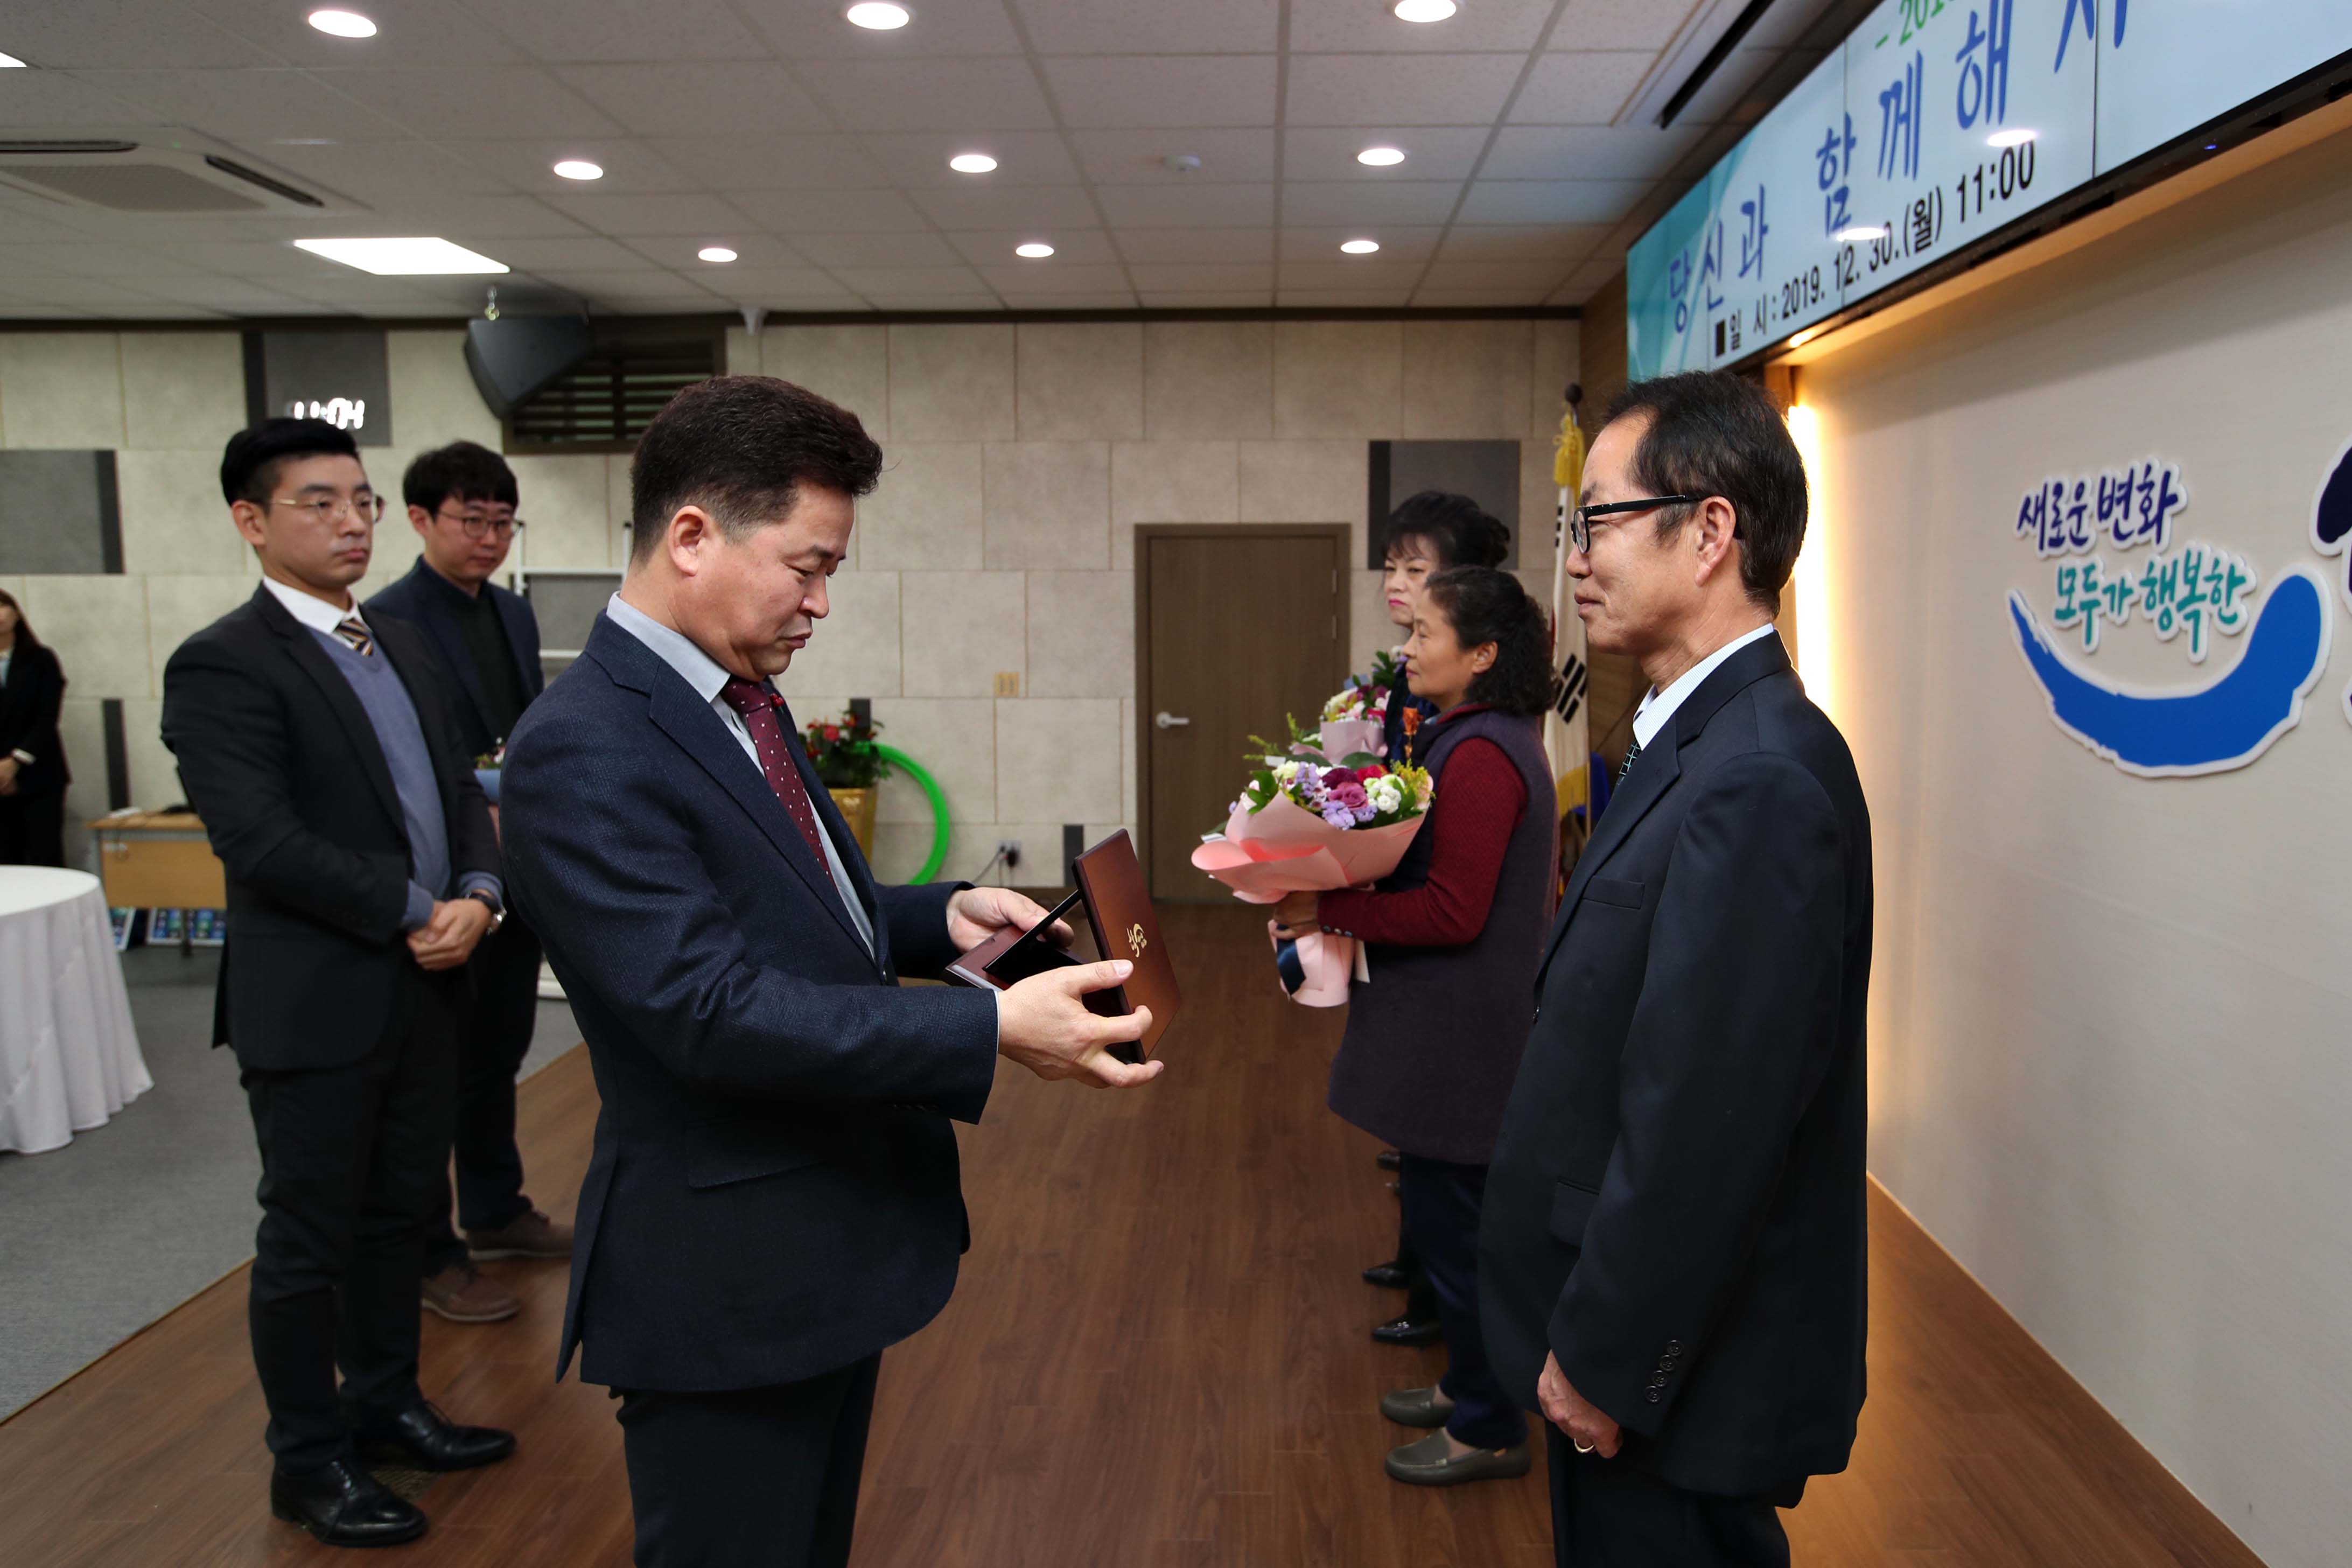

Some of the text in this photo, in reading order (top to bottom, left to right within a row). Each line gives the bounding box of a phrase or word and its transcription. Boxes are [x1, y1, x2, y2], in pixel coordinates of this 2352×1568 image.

[1669, 183, 1769, 333] 당신과
[1782, 265, 1825, 320] 2019.
[1834, 244, 1860, 291] 12.
[1956, 139, 2034, 225] 11:00
[2017, 464, 2179, 551] 새로운 변화
[2053, 548, 2246, 653] 모두가 행복한
